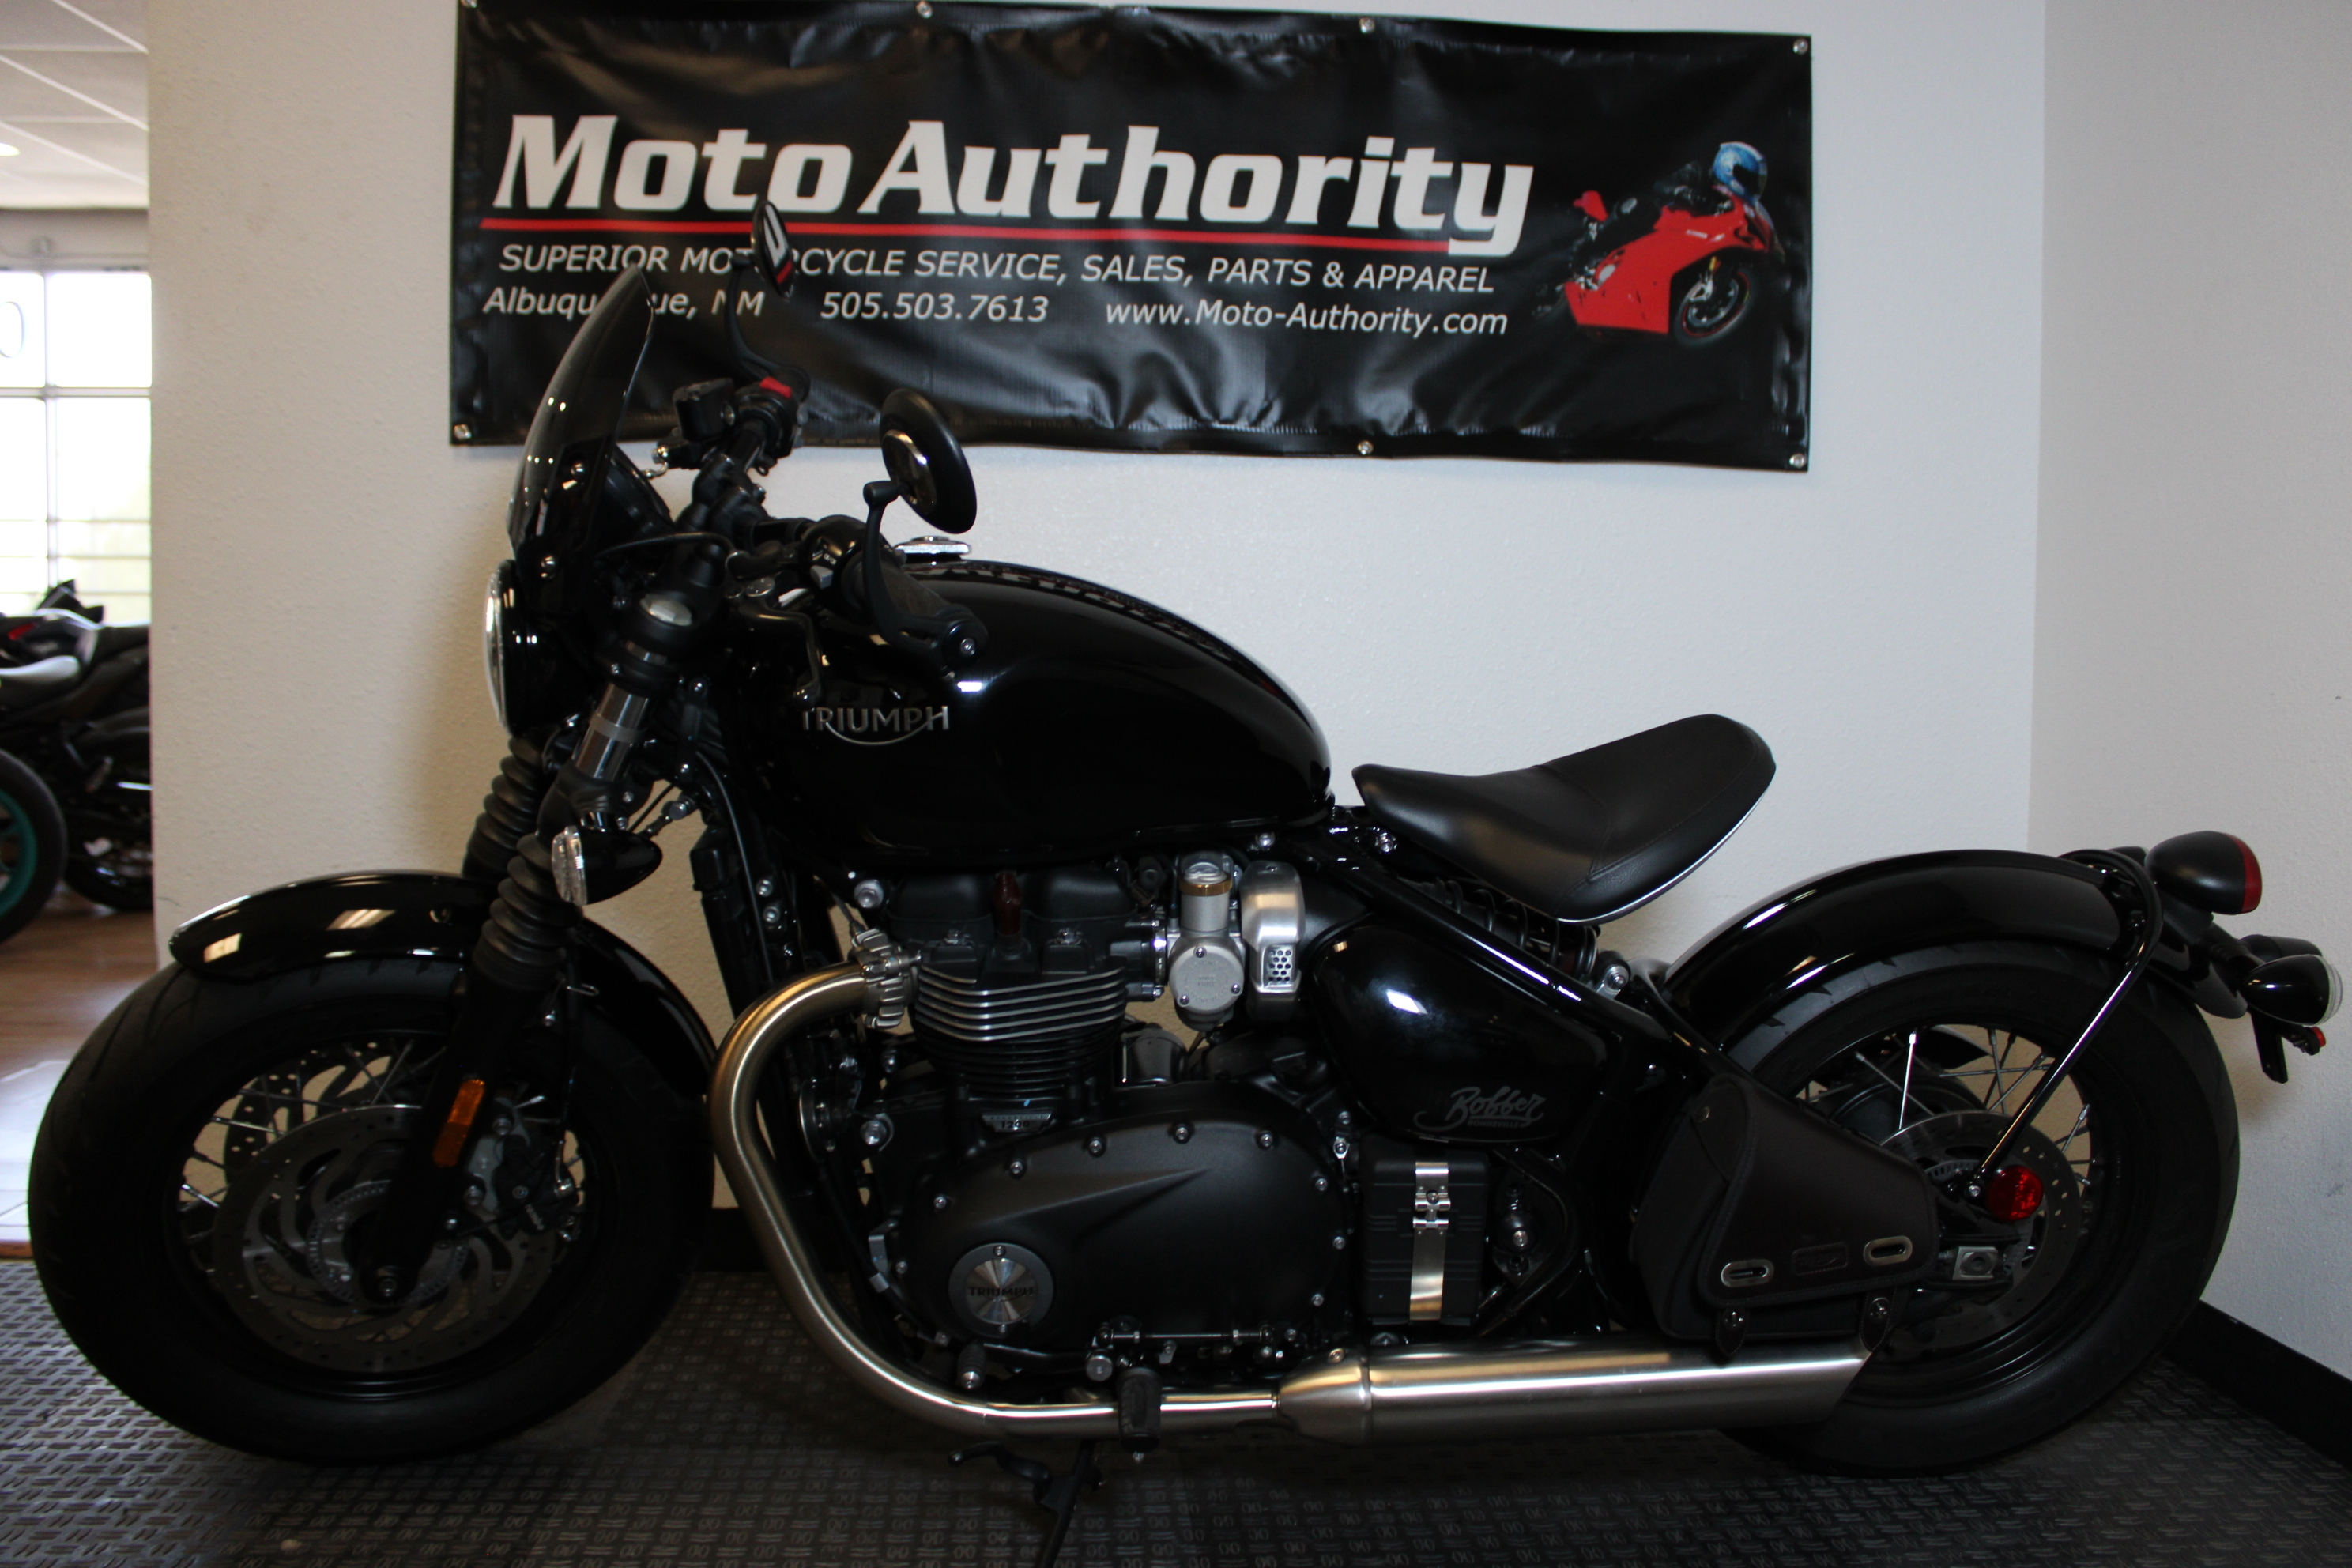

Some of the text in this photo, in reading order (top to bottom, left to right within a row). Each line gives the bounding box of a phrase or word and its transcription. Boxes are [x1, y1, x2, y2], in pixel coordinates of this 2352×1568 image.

[492, 115, 1534, 257] Moto Authority
[499, 244, 1494, 293] SUPERIOR MOCYCLE SERVICE, SALES, PARTS & APPAREL
[482, 286, 697, 321] Albuquue,
[820, 292, 1050, 322] 505.503.7613
[1106, 299, 1508, 338] www.Moto-Authority.com
[1413, 1086, 1547, 1132] Bobber
[968, 1287, 1035, 1298] TRIUMPH
